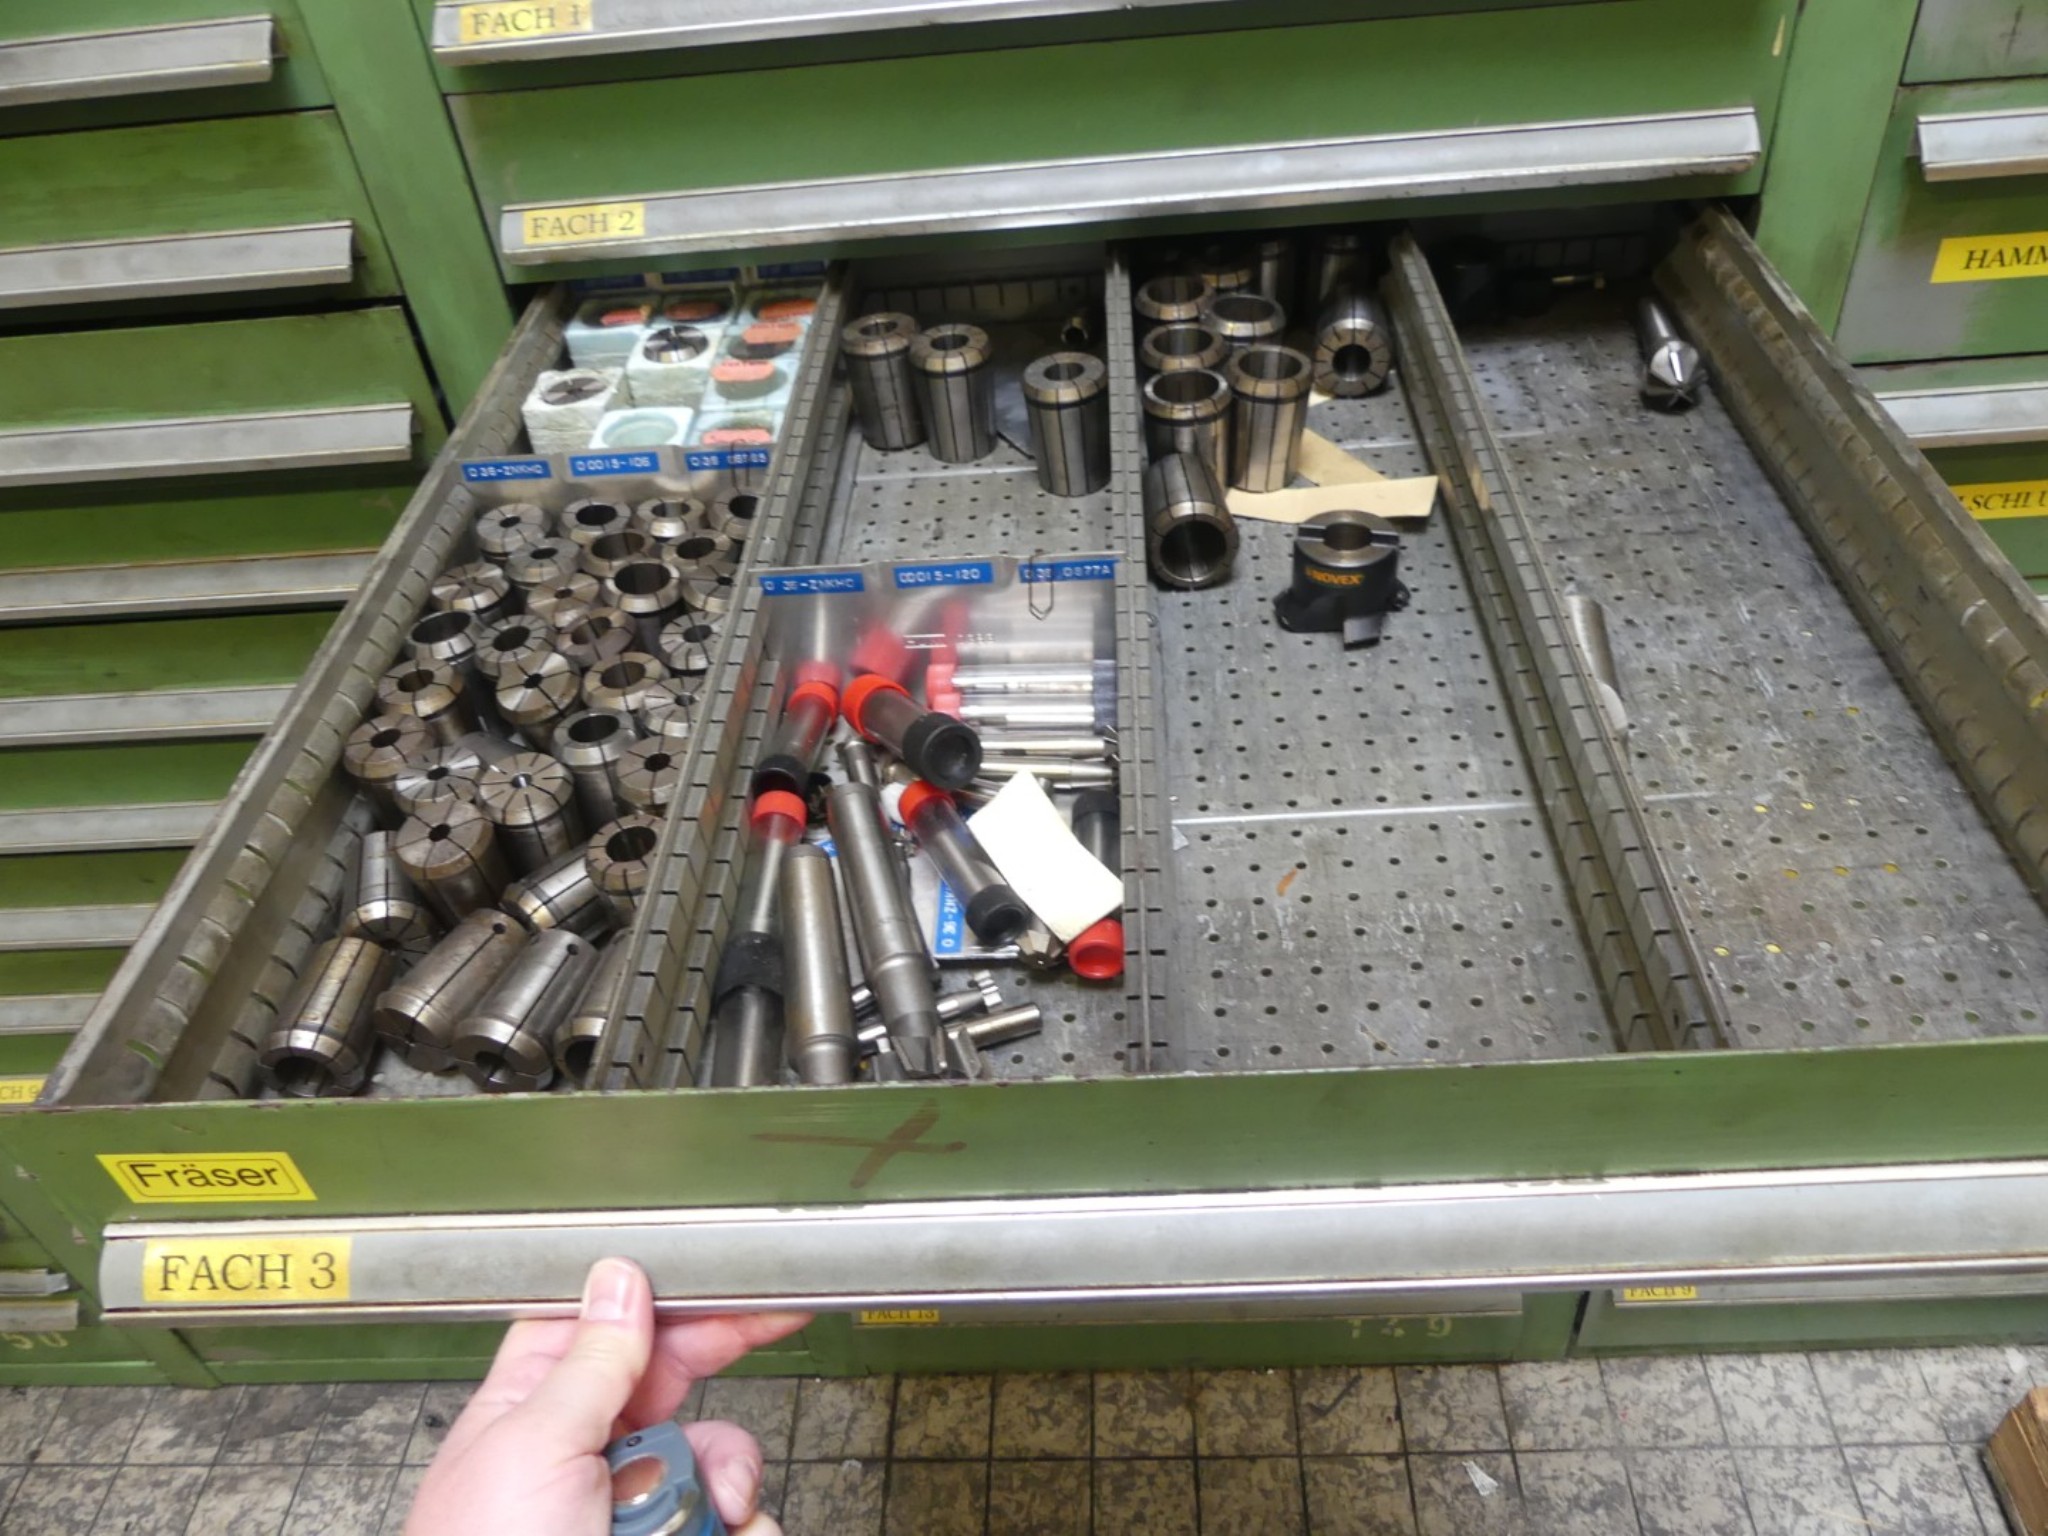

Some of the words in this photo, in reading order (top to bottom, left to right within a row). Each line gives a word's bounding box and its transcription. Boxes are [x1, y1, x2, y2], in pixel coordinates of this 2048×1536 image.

[473, 7, 555, 35] FACH
[531, 212, 609, 239] FACH
[618, 210, 635, 231] 2
[128, 1163, 280, 1188] Fräser
[159, 1253, 293, 1292] FACH
[309, 1252, 336, 1290] 3
